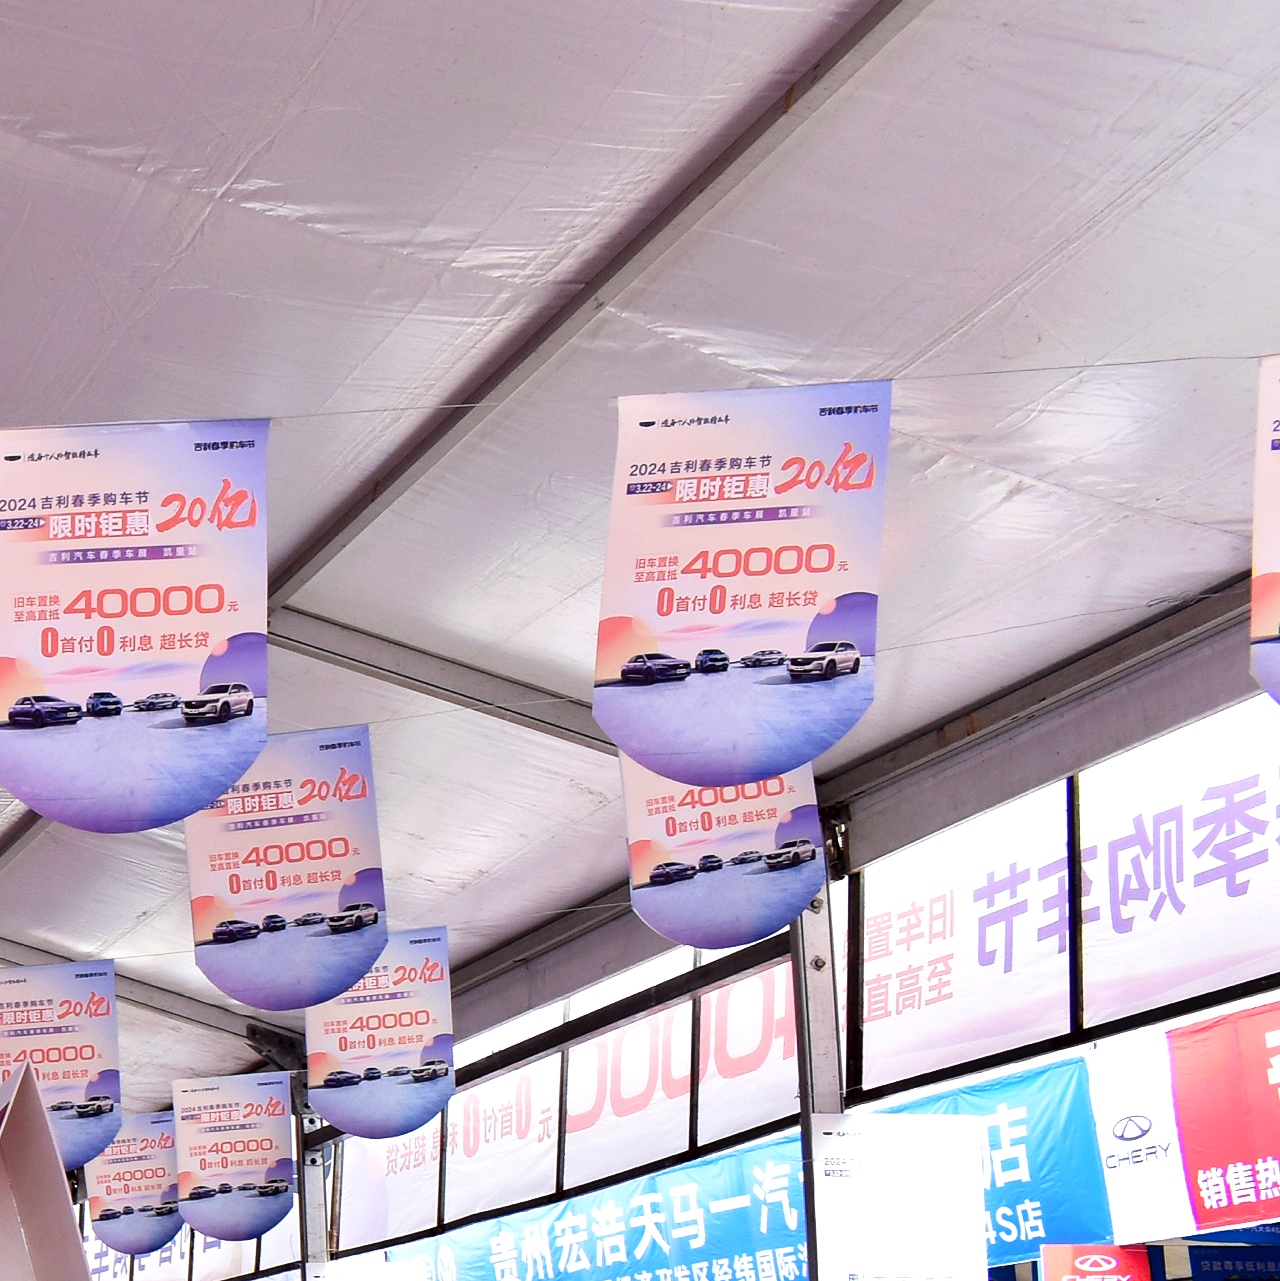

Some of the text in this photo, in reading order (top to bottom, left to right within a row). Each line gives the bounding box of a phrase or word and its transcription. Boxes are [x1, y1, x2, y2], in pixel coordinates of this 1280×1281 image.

[775, 442, 876, 495] 20亿
[675, 474, 772, 502] 限时钜惠
[155, 480, 261, 533] 20亿
[49, 511, 150, 539] 限时钜惠
[297, 767, 368, 806] 20亿
[1105, 1142, 1172, 1170] CHERY
